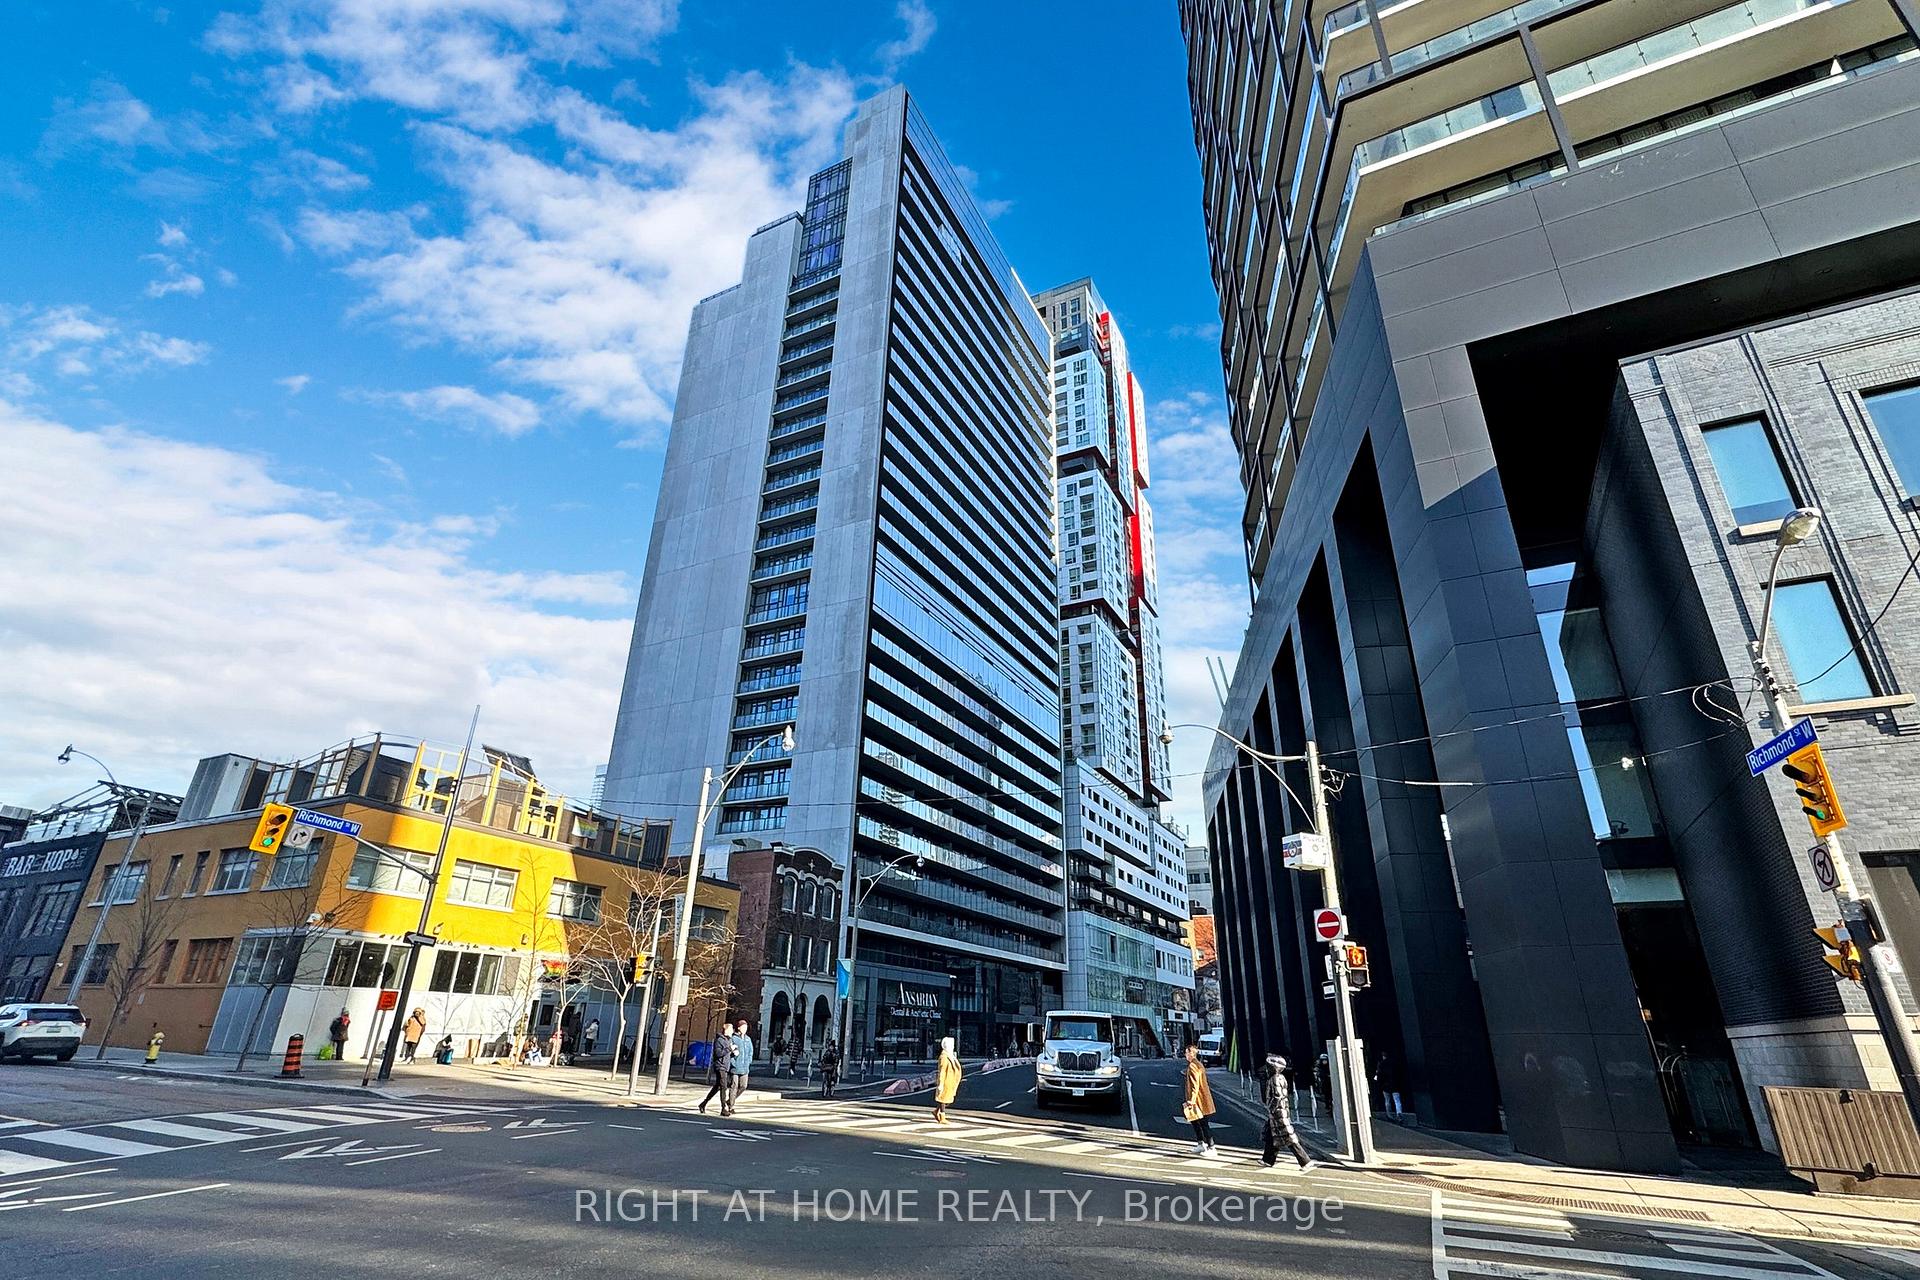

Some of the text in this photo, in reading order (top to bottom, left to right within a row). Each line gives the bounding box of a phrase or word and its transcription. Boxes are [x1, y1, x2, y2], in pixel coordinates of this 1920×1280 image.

[1748, 731, 1796, 770] Richmond
[1800, 720, 1813, 739] W
[298, 810, 344, 830] Richmond
[350, 823, 360, 834] W
[4, 854, 36, 877] BAR
[41, 848, 75, 872] HOP
[896, 982, 938, 1007] ANSARIAN
